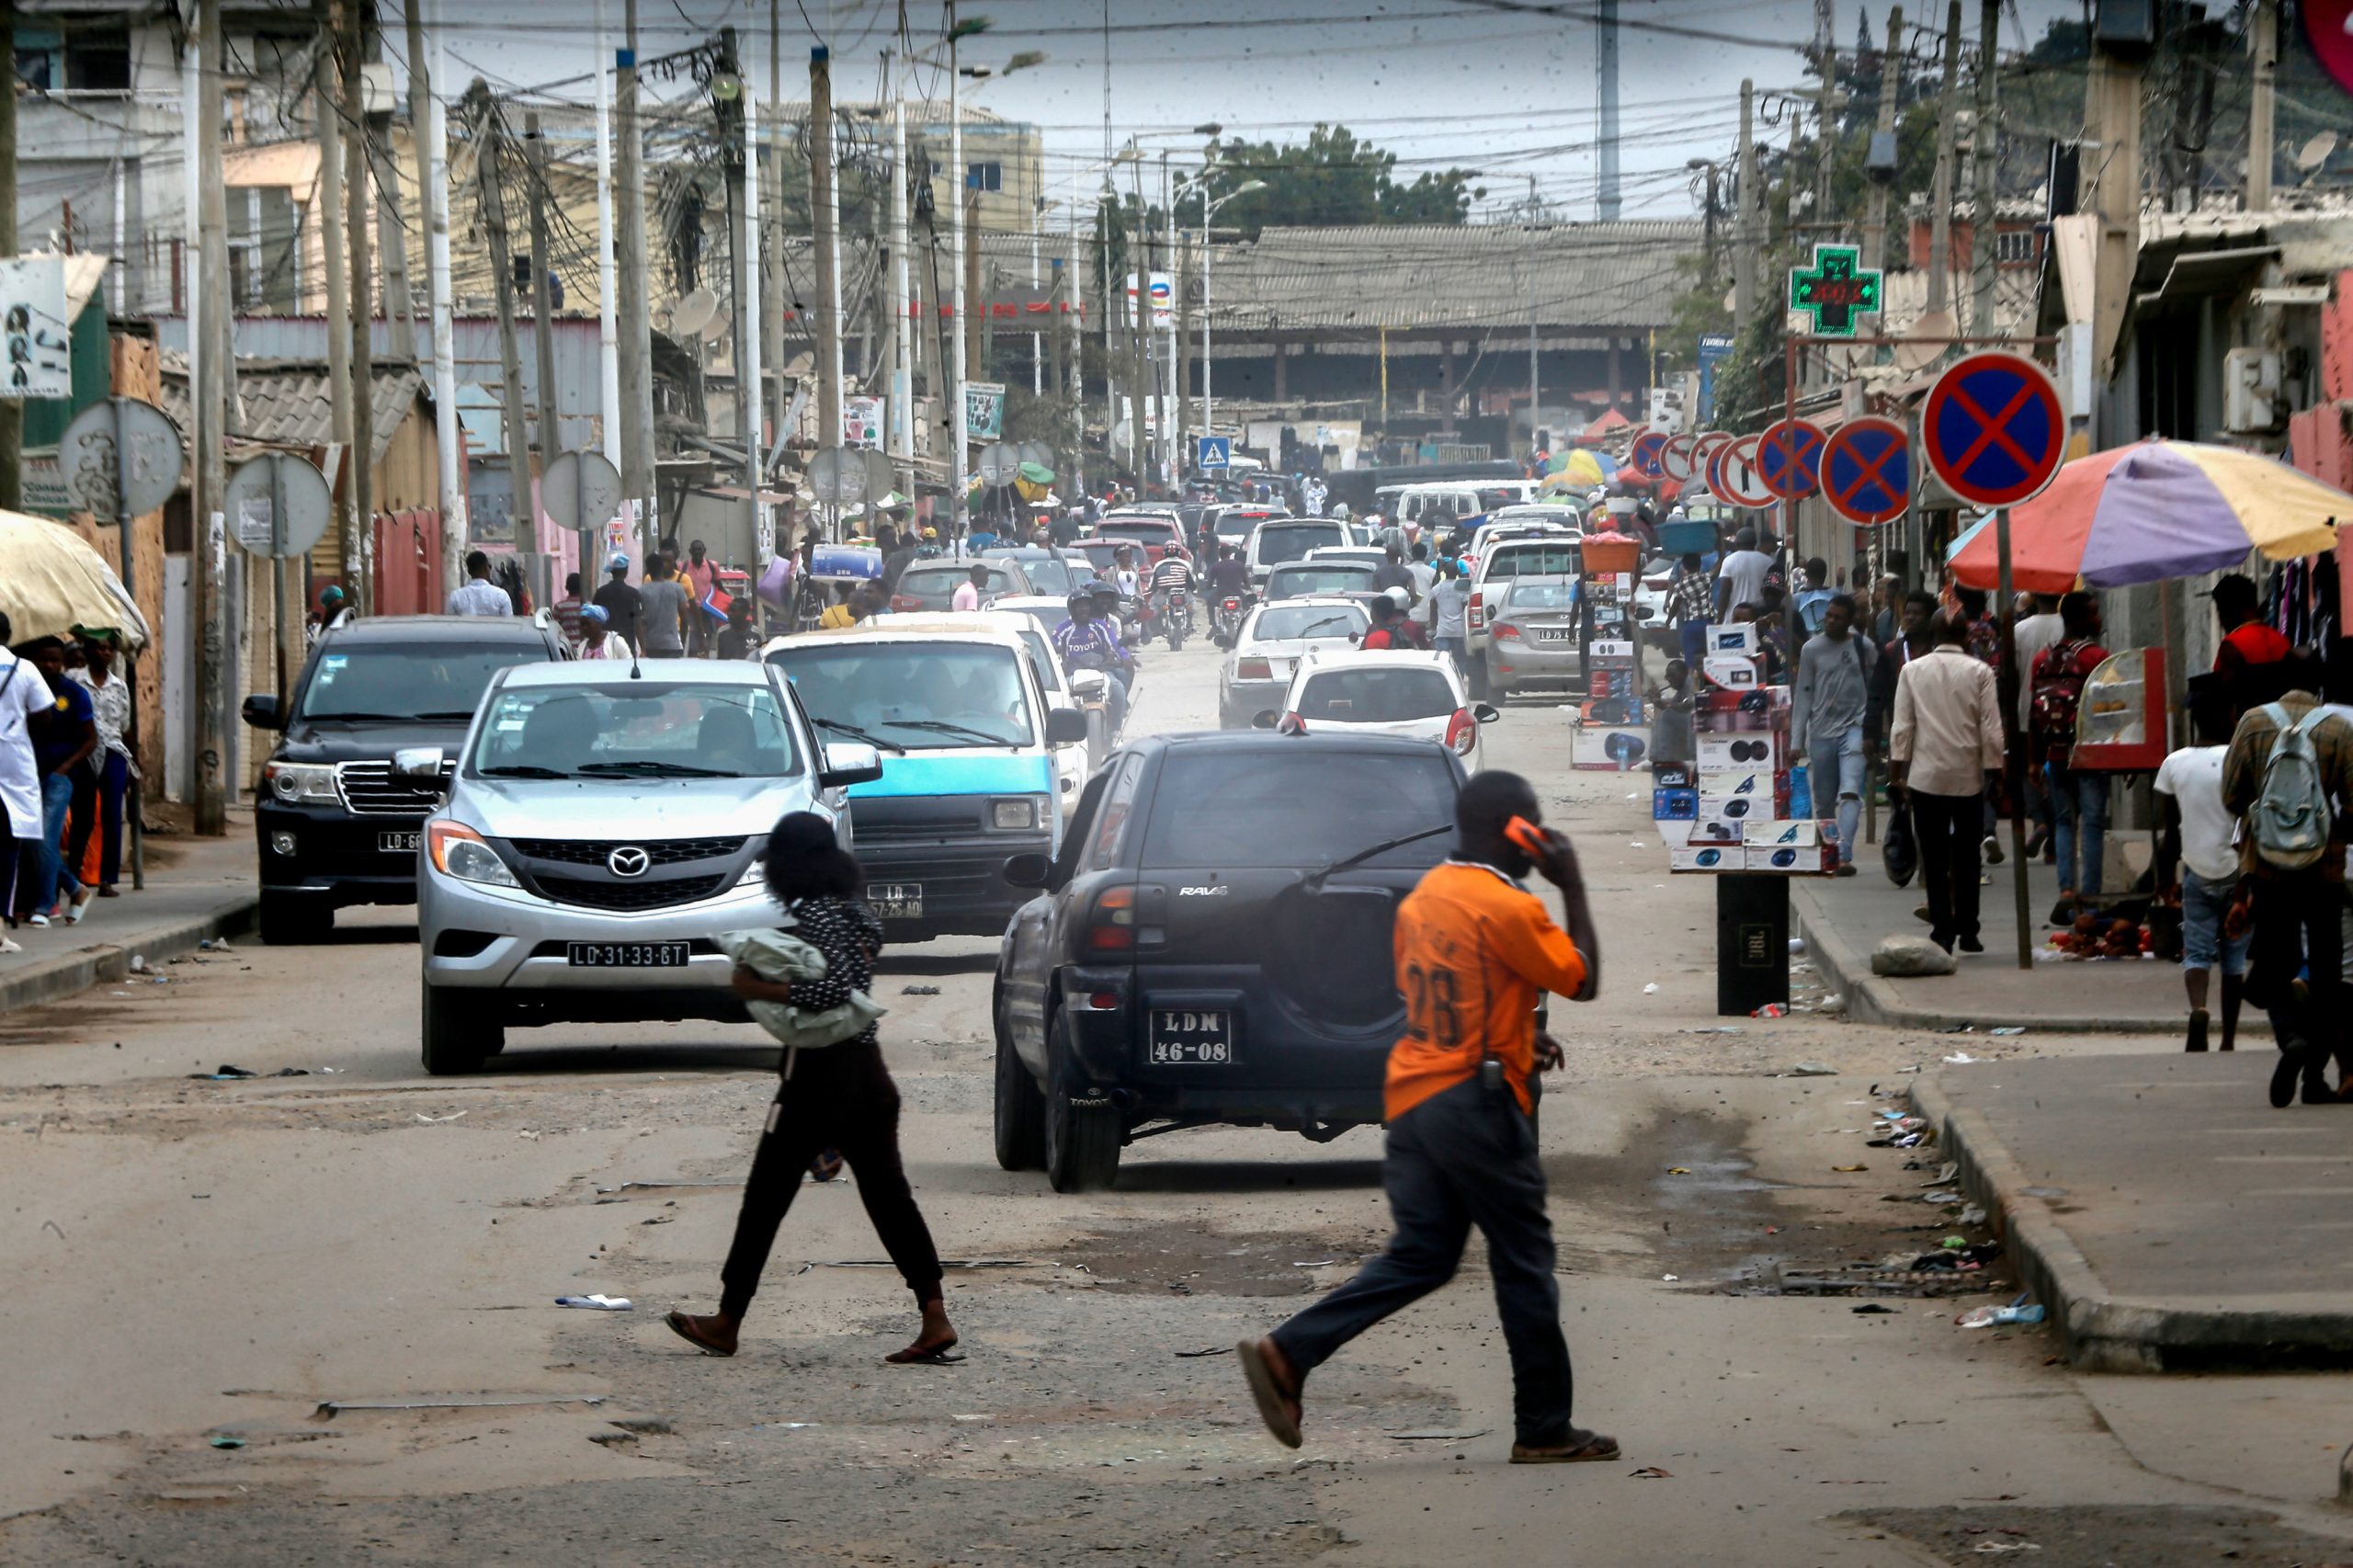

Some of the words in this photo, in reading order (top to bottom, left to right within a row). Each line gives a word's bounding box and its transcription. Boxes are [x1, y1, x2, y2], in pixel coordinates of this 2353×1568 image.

[1068, 642, 1099, 653] TOYOT
[1179, 885, 1228, 896] RAV4
[1165, 1013, 1220, 1031] LDN
[1154, 1042, 1226, 1061] 46-08
[1070, 1097, 1109, 1106] TOYOT
